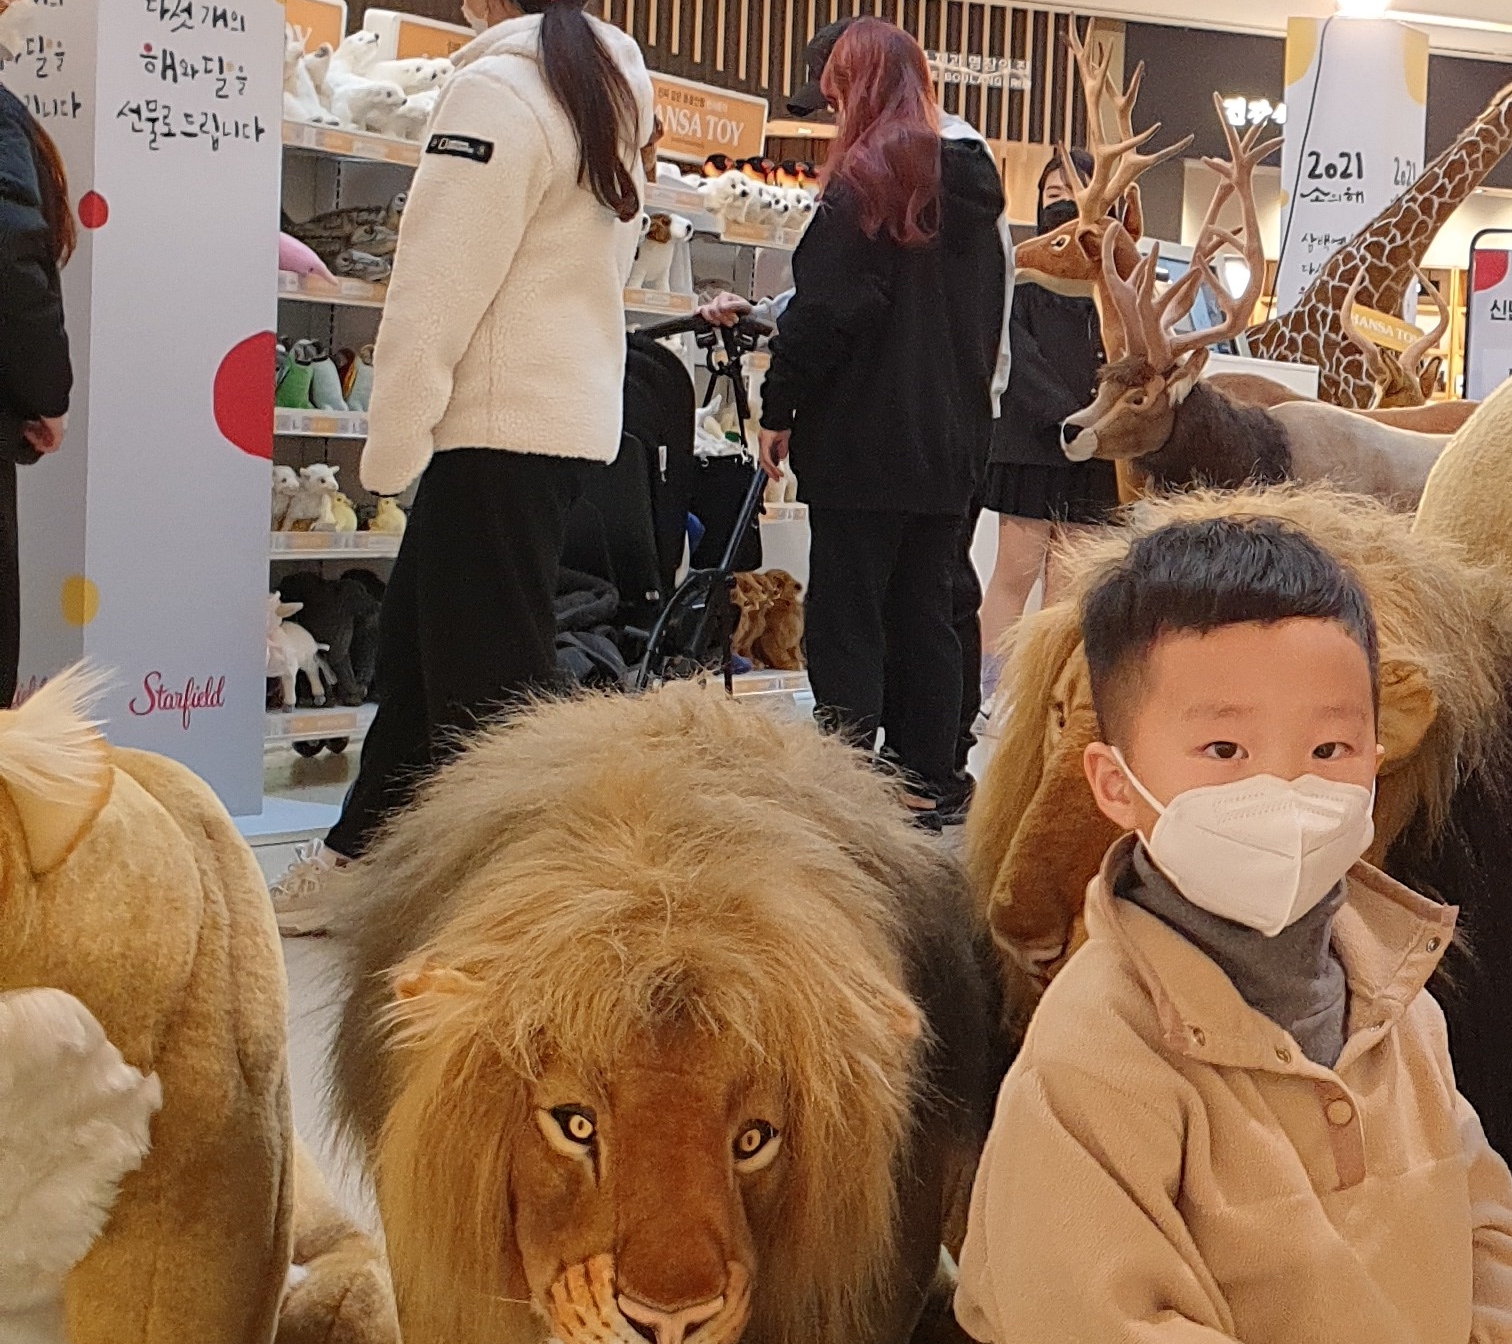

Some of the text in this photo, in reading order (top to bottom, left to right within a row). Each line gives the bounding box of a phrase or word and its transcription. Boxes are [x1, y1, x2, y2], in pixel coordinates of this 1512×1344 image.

[201, 5, 246, 32] 개의
[654, 104, 702, 138] ANSA
[706, 115, 745, 147] TOY
[1307, 150, 1364, 180] 2021
[1393, 157, 1417, 187] 2021
[1301, 232, 1354, 253] 삼백예
[128, 670, 226, 731] Starfield
